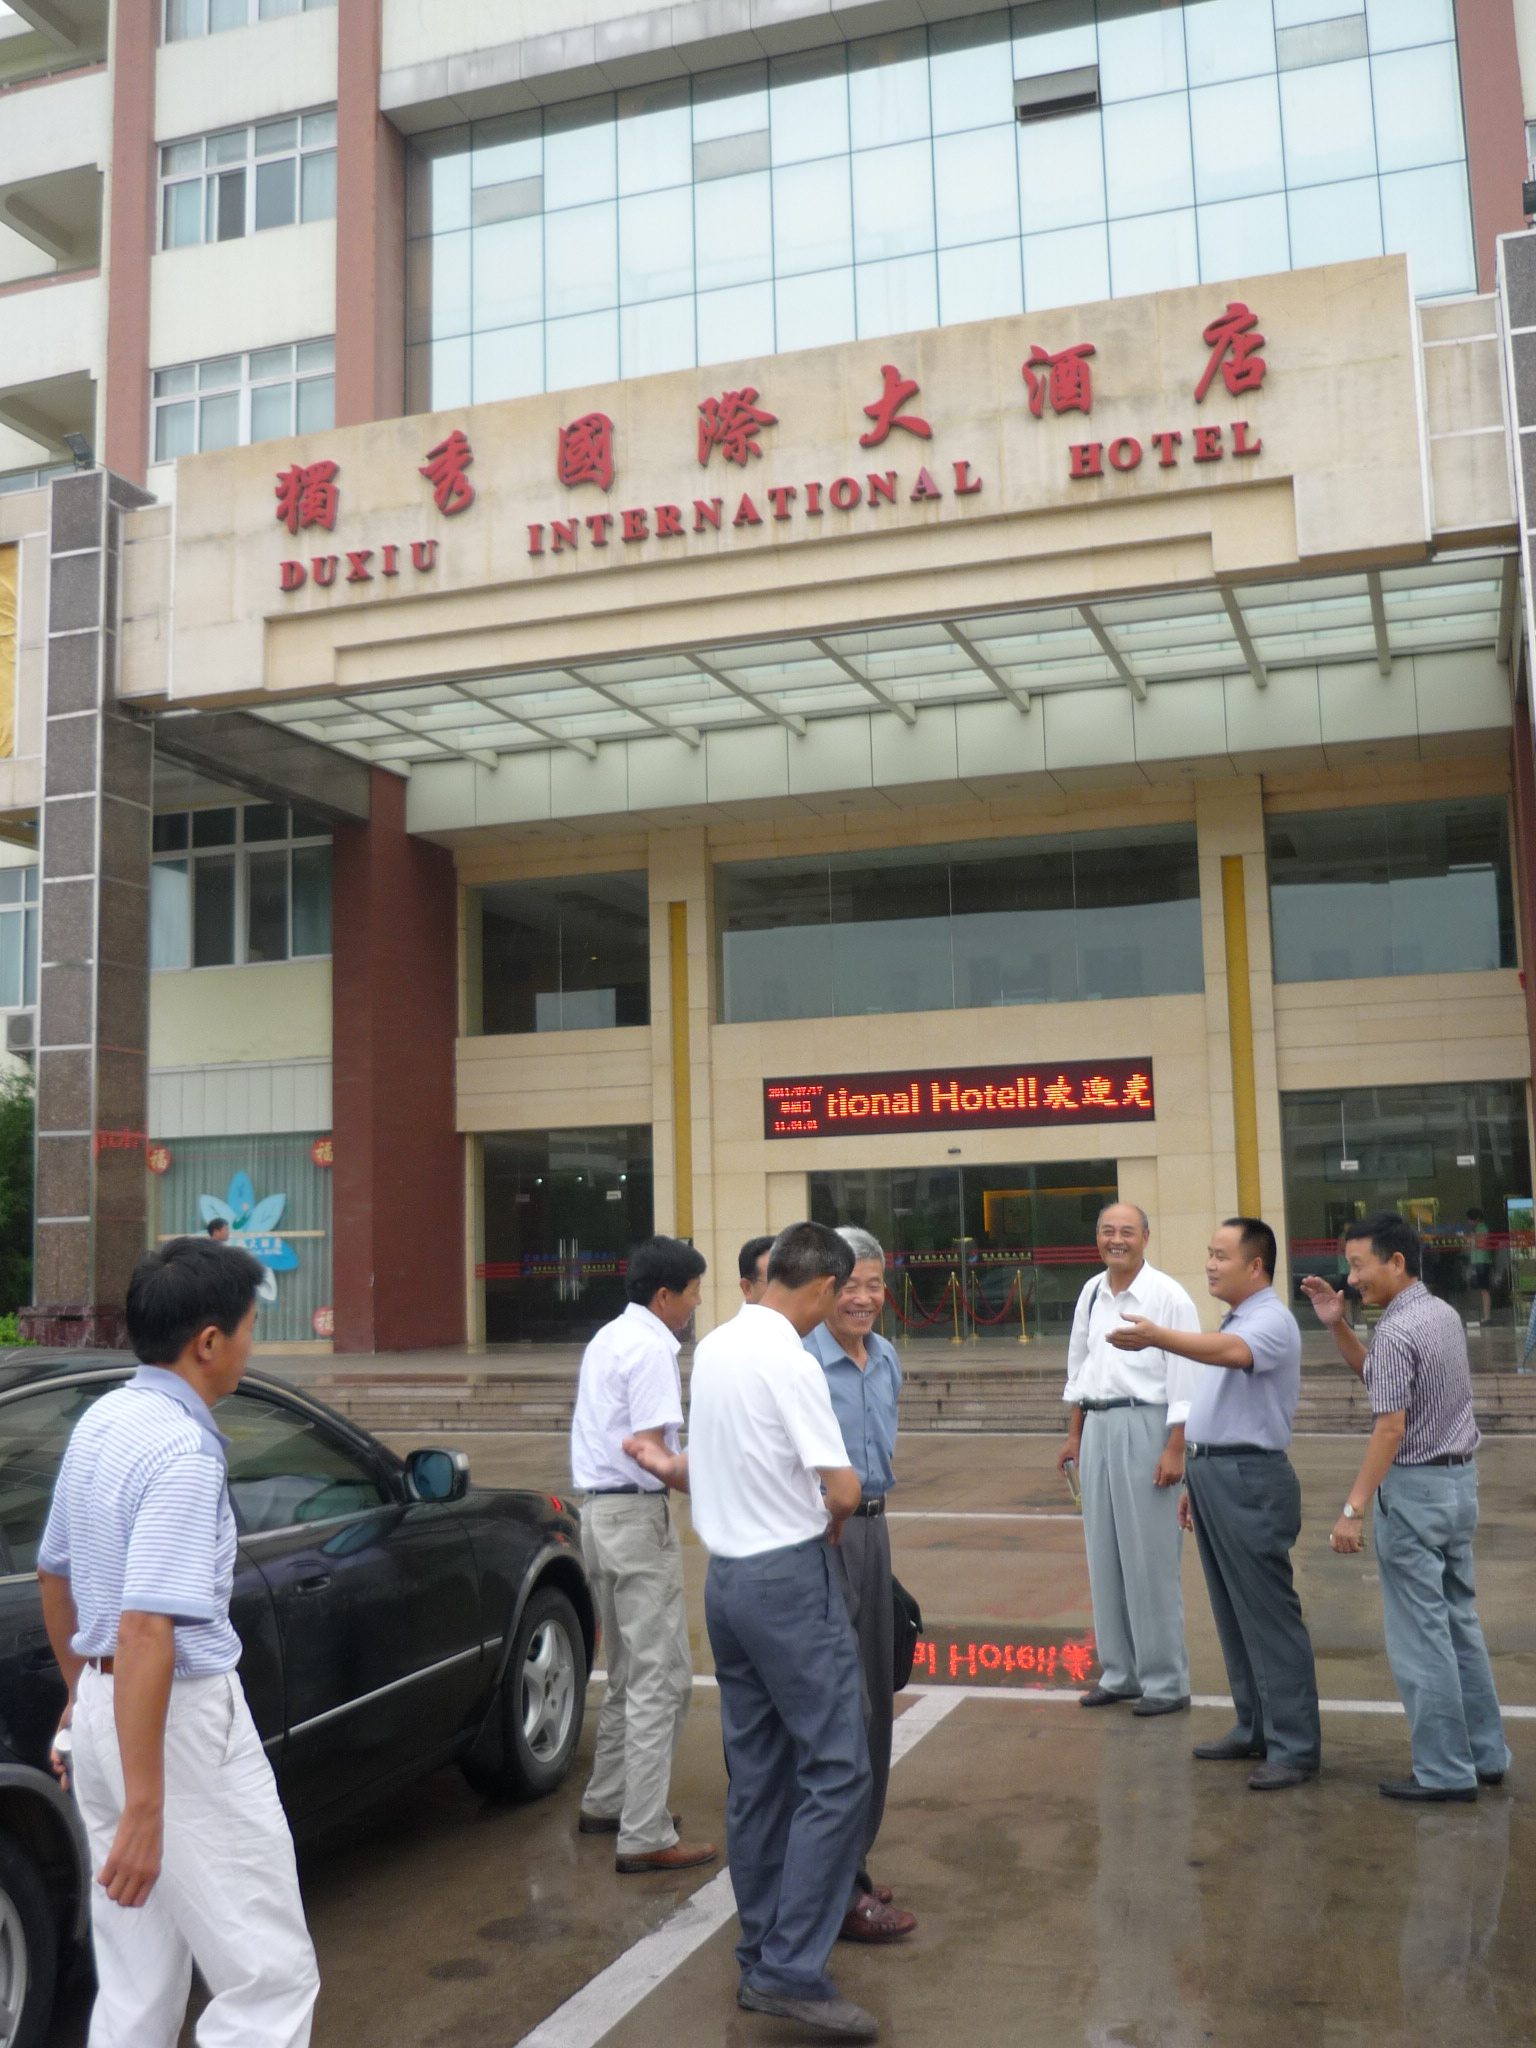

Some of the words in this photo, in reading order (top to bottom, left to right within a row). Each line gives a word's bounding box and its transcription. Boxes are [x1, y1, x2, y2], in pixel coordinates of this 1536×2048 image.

[280, 539, 439, 592] DUXIU
[527, 460, 983, 556] INTERNATIONAL
[1069, 421, 1262, 479] HOTEL
[827, 1083, 921, 1118] tional
